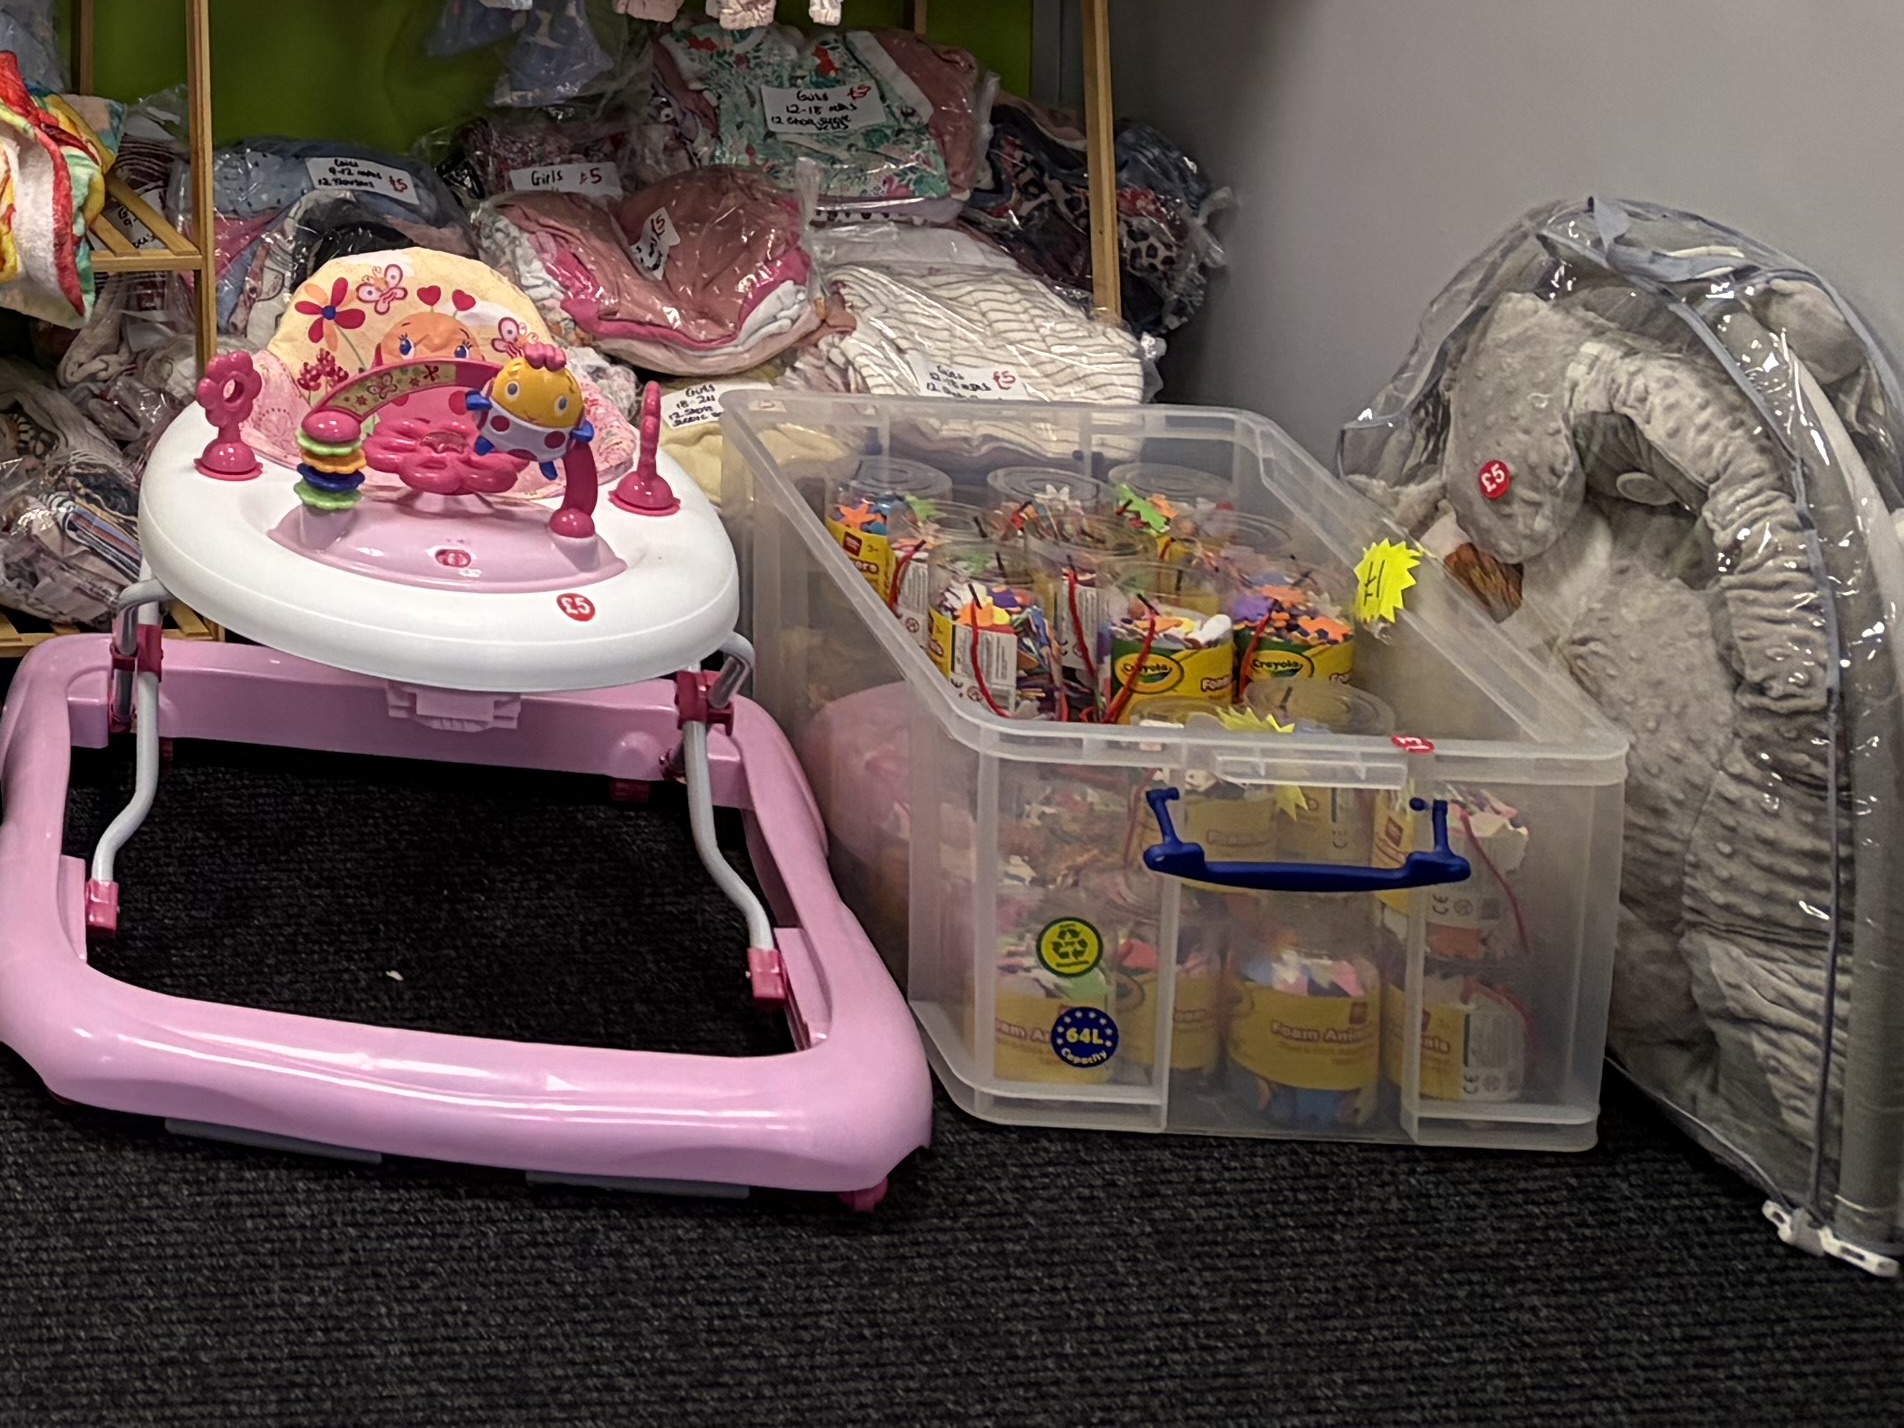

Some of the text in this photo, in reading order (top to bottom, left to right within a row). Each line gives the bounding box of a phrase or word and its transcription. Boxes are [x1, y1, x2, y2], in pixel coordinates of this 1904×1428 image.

[531, 170, 563, 188] Girls
[1478, 461, 1507, 495] £5
[559, 594, 595, 620] £5
[1065, 1026, 1104, 1045] 64L
[1060, 1047, 1108, 1066] Capacity
